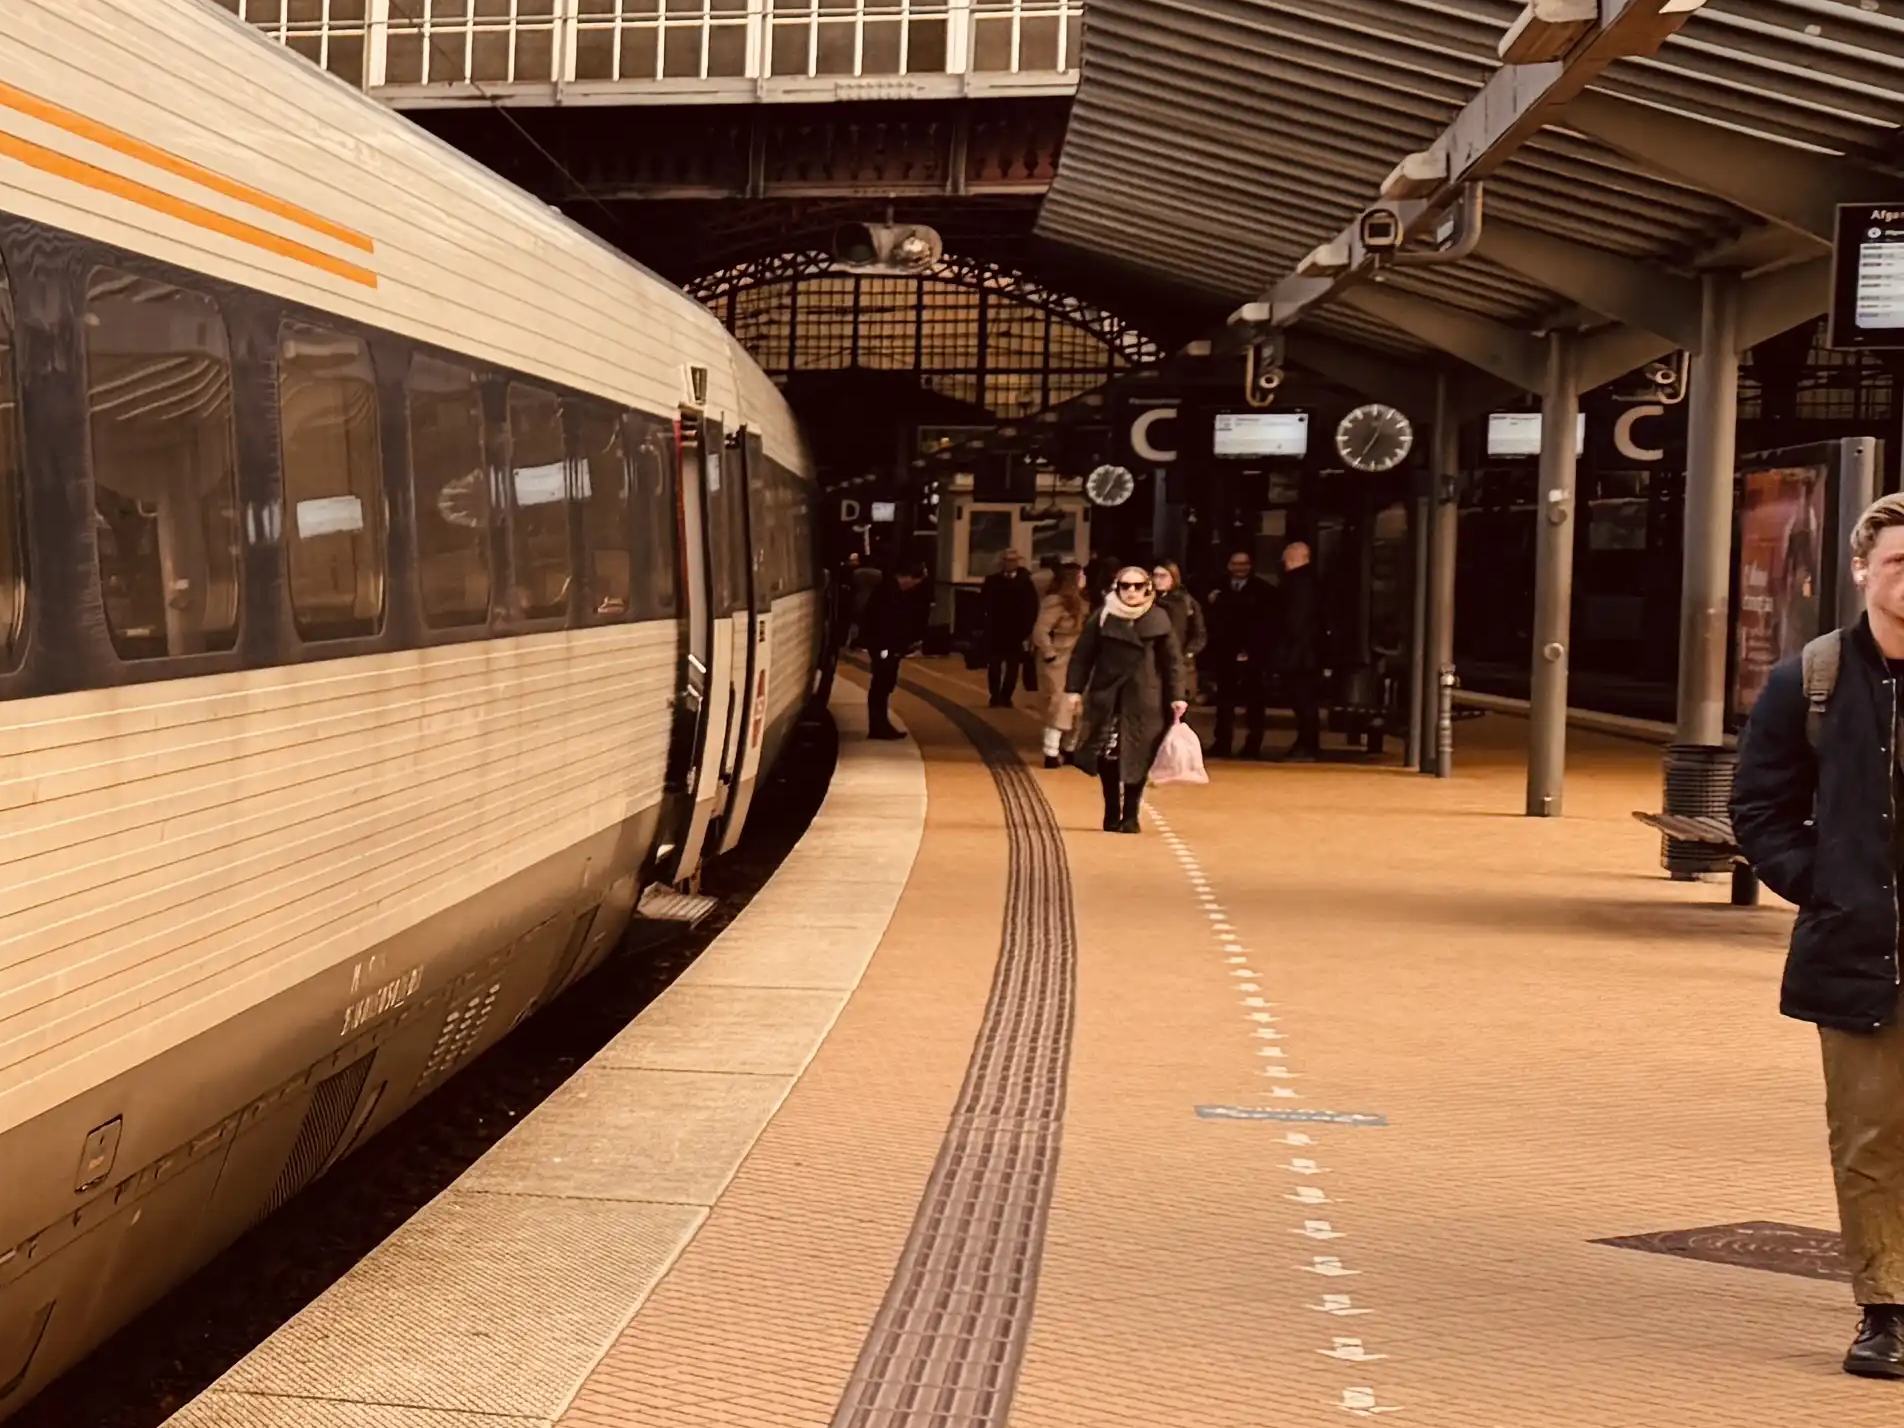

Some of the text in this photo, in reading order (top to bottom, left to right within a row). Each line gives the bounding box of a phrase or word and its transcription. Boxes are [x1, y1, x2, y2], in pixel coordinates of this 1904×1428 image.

[1130, 408, 1178, 462] C
[1614, 405, 1664, 461] C
[840, 498, 861, 522] D
